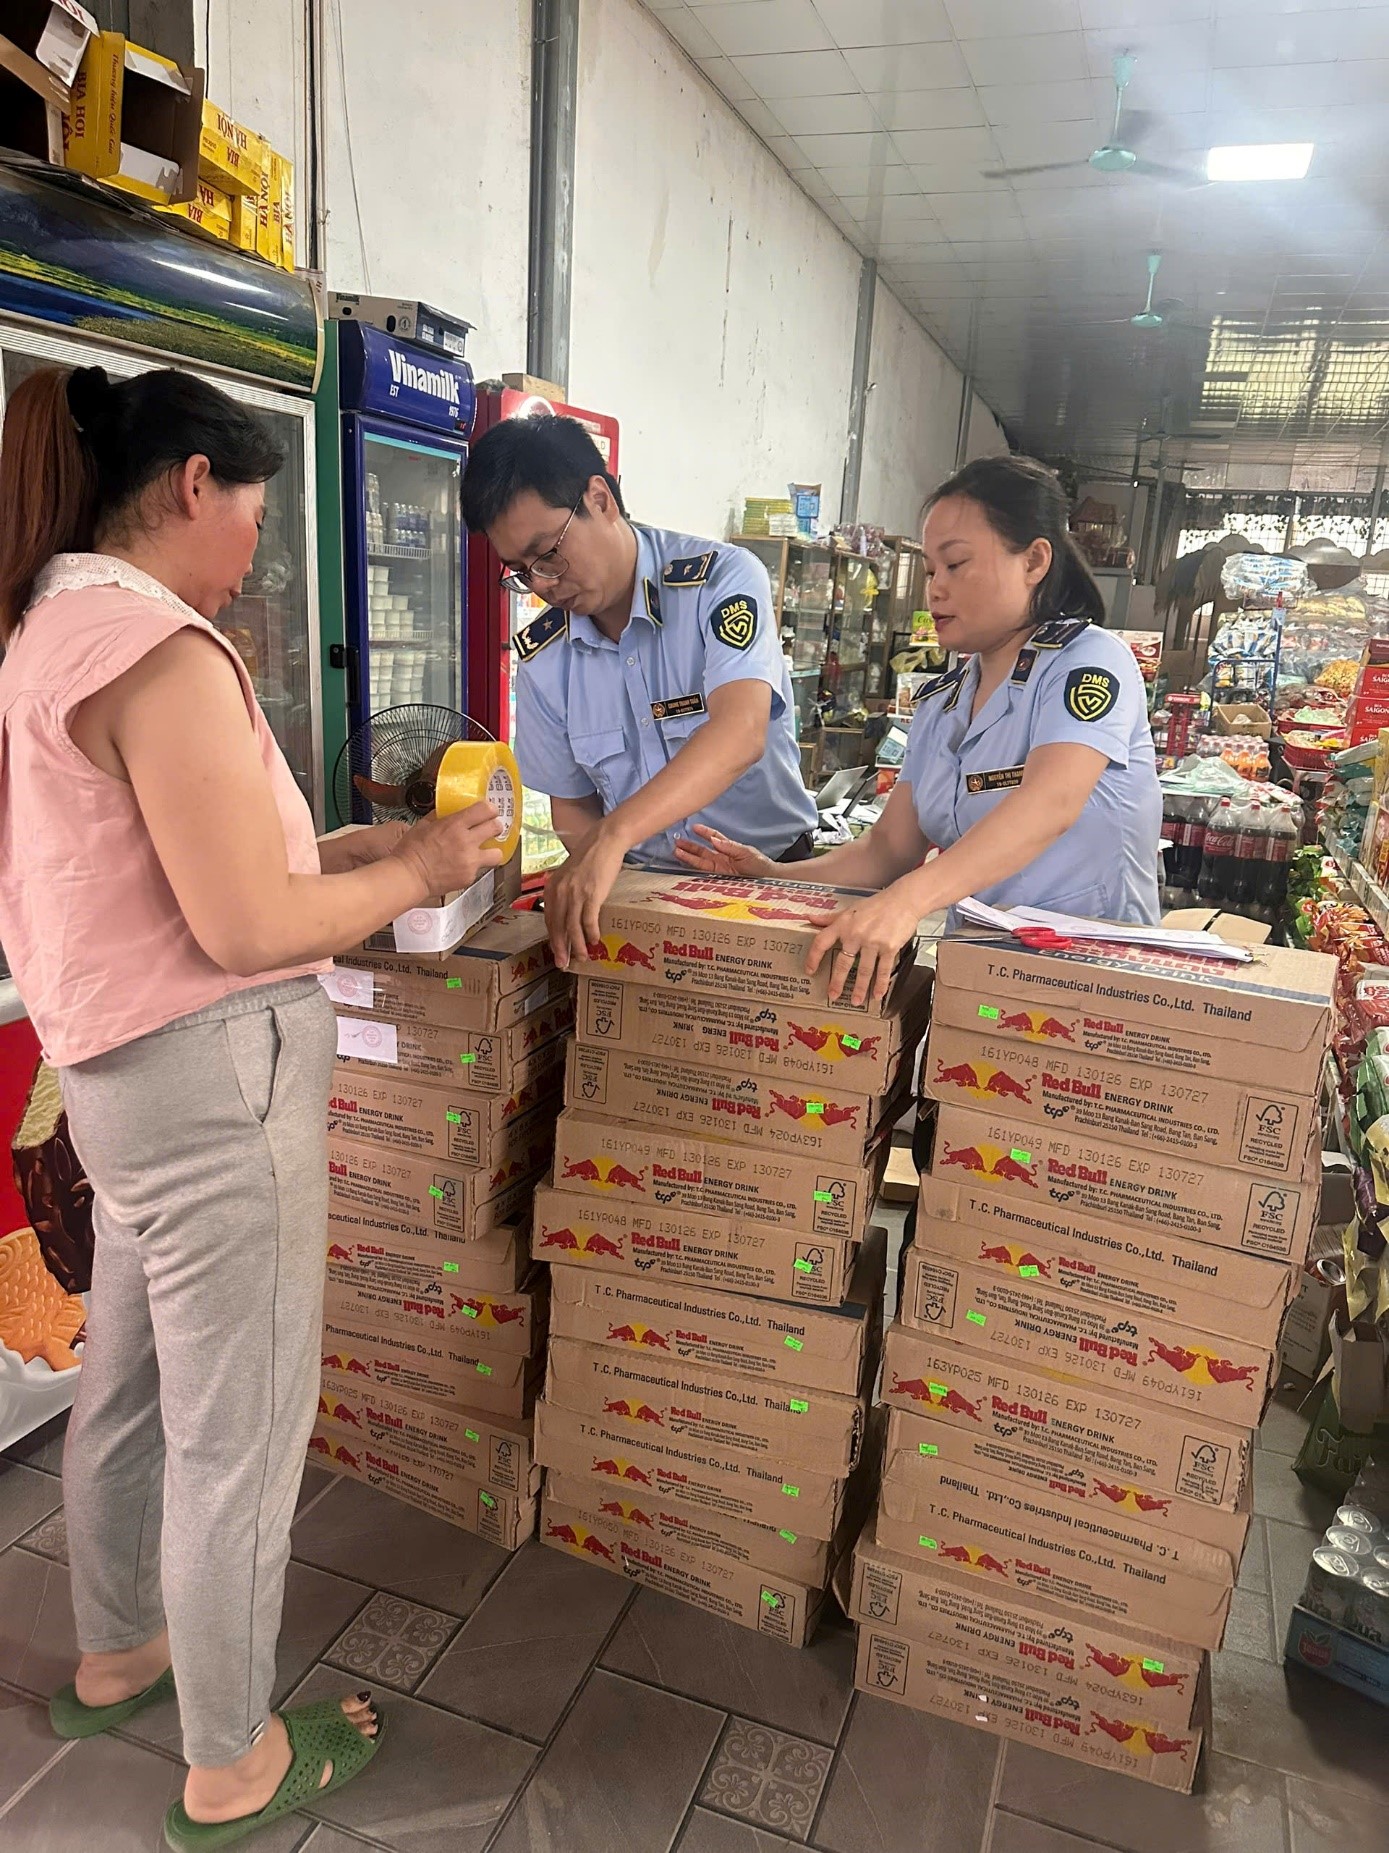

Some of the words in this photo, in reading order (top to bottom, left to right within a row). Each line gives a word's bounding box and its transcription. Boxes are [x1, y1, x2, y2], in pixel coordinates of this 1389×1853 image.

[388, 349, 461, 405] Vinamilk
[389, 384, 400, 398] EST
[720, 600, 748, 619] DMS
[1081, 672, 1110, 688] DMS
[671, 881, 754, 899] Bull
[755, 892, 839, 909] Red
[612, 918, 661, 935] 161YP050
[667, 926, 685, 938] MFD
[693, 929, 729, 944] 130126
[737, 936, 755, 948] EXP
[764, 940, 803, 955] 130727
[663, 941, 687, 957] Red
[689, 944, 713, 961] Bull
[716, 954, 746, 965] ENERGY
[748, 958, 772, 969] DRINK
[345, 957, 381, 970] Industries
[417, 966, 448, 979] Thailand
[664, 957, 698, 968] Manufactured
[707, 963, 715, 971] T.C.
[717, 965, 759, 977] PHARMACEUTICAL
[761, 971, 790, 981] INDUSTRIES
[800, 976, 811, 984] LTD.
[664, 968, 686, 983] tcp
[1039, 949, 1129, 969] Energy
[1140, 963, 1213, 983] Drink
[1013, 969, 1093, 995] Pharmaceutical
[1097, 983, 1149, 1004] Industries
[1203, 1001, 1252, 1022] Thailand
[1042, 1072, 1070, 1094] Red
[1072, 1077, 1101, 1099] Bull
[1046, 1059, 1068, 1076] MFD
[1077, 1065, 1121, 1087] 130126
[1130, 1076, 1152, 1093] EXP
[1162, 1082, 1208, 1104] 130727
[338, 1099, 358, 1112] Bull
[359, 1108, 382, 1118] ENERGY
[384, 1112, 403, 1121] DRINK
[1042, 1090, 1082, 1106] Manufactured
[1084, 1099, 1093, 1108] by:
[1094, 1101, 1103, 1110] T.C.
[1105, 1104, 1157, 1122] PHARMACEUTICAL
[1159, 1115, 1192, 1129] INDUSTRIES
[1207, 1126, 1219, 1135] LTD.
[1044, 1103, 1069, 1119] tcp
[1105, 1093, 1141, 1107] ENERGY
[1144, 1100, 1173, 1113] DRINK
[1259, 1124, 1281, 1135] FSC
[1250, 1137, 1283, 1149] RECYCLED
[652, 1164, 676, 1180] Red
[678, 1167, 702, 1184] Bull
[657, 1147, 675, 1161] MFD
[683, 1151, 720, 1168] 130126
[727, 1159, 745, 1172] EXP
[753, 1163, 791, 1179] 130727
[1048, 1159, 1075, 1179] Red
[1078, 1164, 1107, 1184] Bull
[1049, 1140, 1069, 1157] MFD
[1078, 1146, 1121, 1168] 130126
[1130, 1158, 1150, 1175] EXP
[1159, 1164, 1204, 1187] 130727
[704, 1177, 733, 1189] ENERGY
[736, 1182, 759, 1194] DRINK
[1110, 1178, 1145, 1193] ENERGY
[1148, 1186, 1177, 1199] DRINK
[363, 1217, 399, 1231] Industries
[1260, 1211, 1283, 1221] FSC
[633, 1217, 651, 1230] MFD
[659, 1222, 696, 1237] 130126
[702, 1228, 720, 1241] EXP
[728, 1232, 765, 1247] 130727
[1253, 1223, 1285, 1235] RECYCLED
[631, 1232, 654, 1248] Red
[656, 1236, 680, 1252] Bull
[683, 1245, 712, 1256] ENERGY
[715, 1249, 738, 1260] DRINK
[994, 1206, 1070, 1238] Pharmaceutical
[1073, 1227, 1123, 1252] Industries
[1172, 1253, 1218, 1277] Thailand
[616, 1289, 681, 1311] Pharmaceutical
[684, 1302, 726, 1320] Industries
[767, 1318, 805, 1336] Thailand
[326, 1324, 379, 1343] Pharmaceutical
[381, 1337, 415, 1351] Industries
[449, 1352, 479, 1365] Thailand
[614, 1366, 678, 1389] Pharmaceutical
[681, 1380, 723, 1398] Industries
[988, 1374, 1008, 1392] MFD
[1017, 1382, 1058, 1406] 130126
[1066, 1397, 1086, 1414] EXP
[1095, 1405, 1140, 1430] 130727
[992, 1395, 1018, 1417] Red
[1020, 1401, 1047, 1424] Bull
[1051, 1418, 1084, 1436] ENERGY
[1087, 1426, 1115, 1443] DRINK
[600, 1432, 663, 1454] Pharmaceutical
[666, 1447, 706, 1465] Industries
[747, 1466, 783, 1483] Thailand
[940, 1475, 980, 1498] Thailand
[1024, 1501, 1072, 1527] Industries
[1075, 1517, 1153, 1553] Pharmaceutical
[952, 1511, 1025, 1542] Pharmaceutical
[1028, 1532, 1075, 1557] Industries
[1123, 1559, 1166, 1584] Thailand
